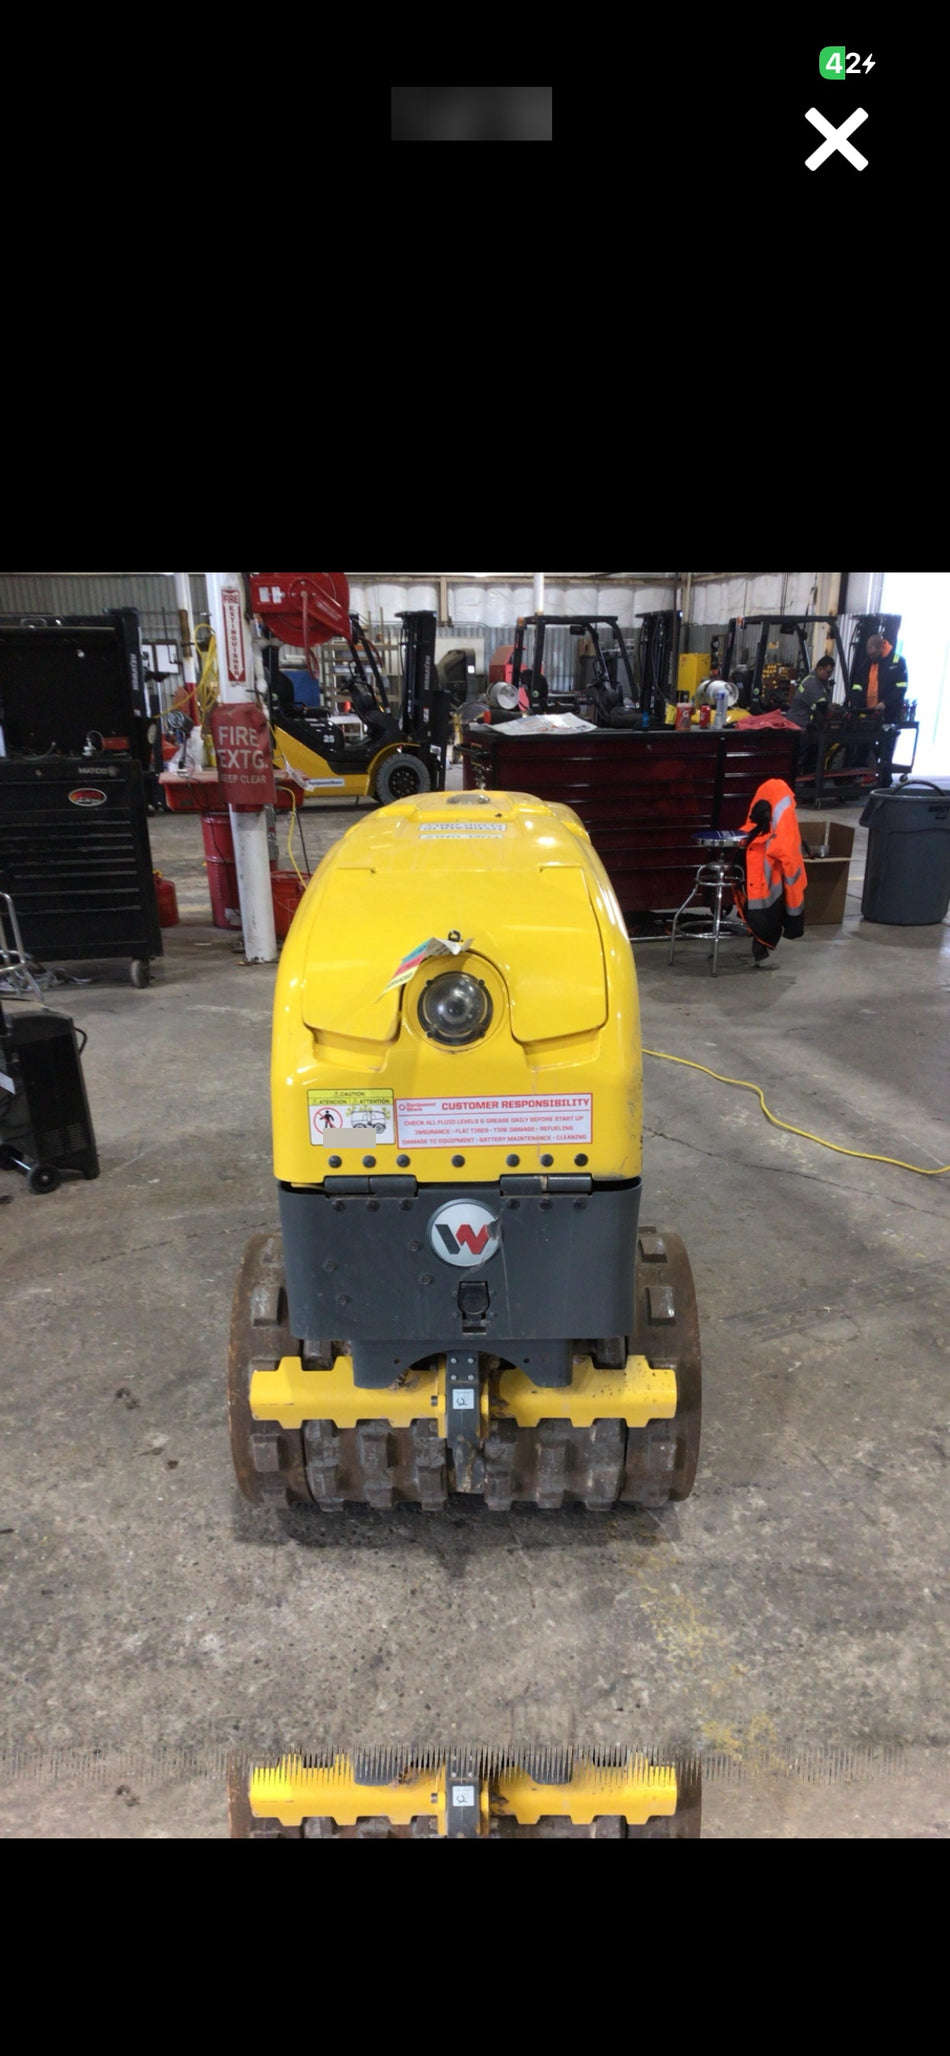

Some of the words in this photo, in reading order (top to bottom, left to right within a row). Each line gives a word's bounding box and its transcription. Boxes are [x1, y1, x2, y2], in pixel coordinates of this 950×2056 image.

[229, 605, 239, 675] EXTINGUISHER
[218, 726, 259, 747] FIRE
[323, 735, 335, 743] 25
[217, 749, 268, 769] EXTG.
[240, 775, 267, 784] CLEAR
[442, 1101, 498, 1110] CUSTOMER
[502, 1099, 589, 1108] RESPONSIBILITY
[479, 1135, 506, 1143] BATTERY
